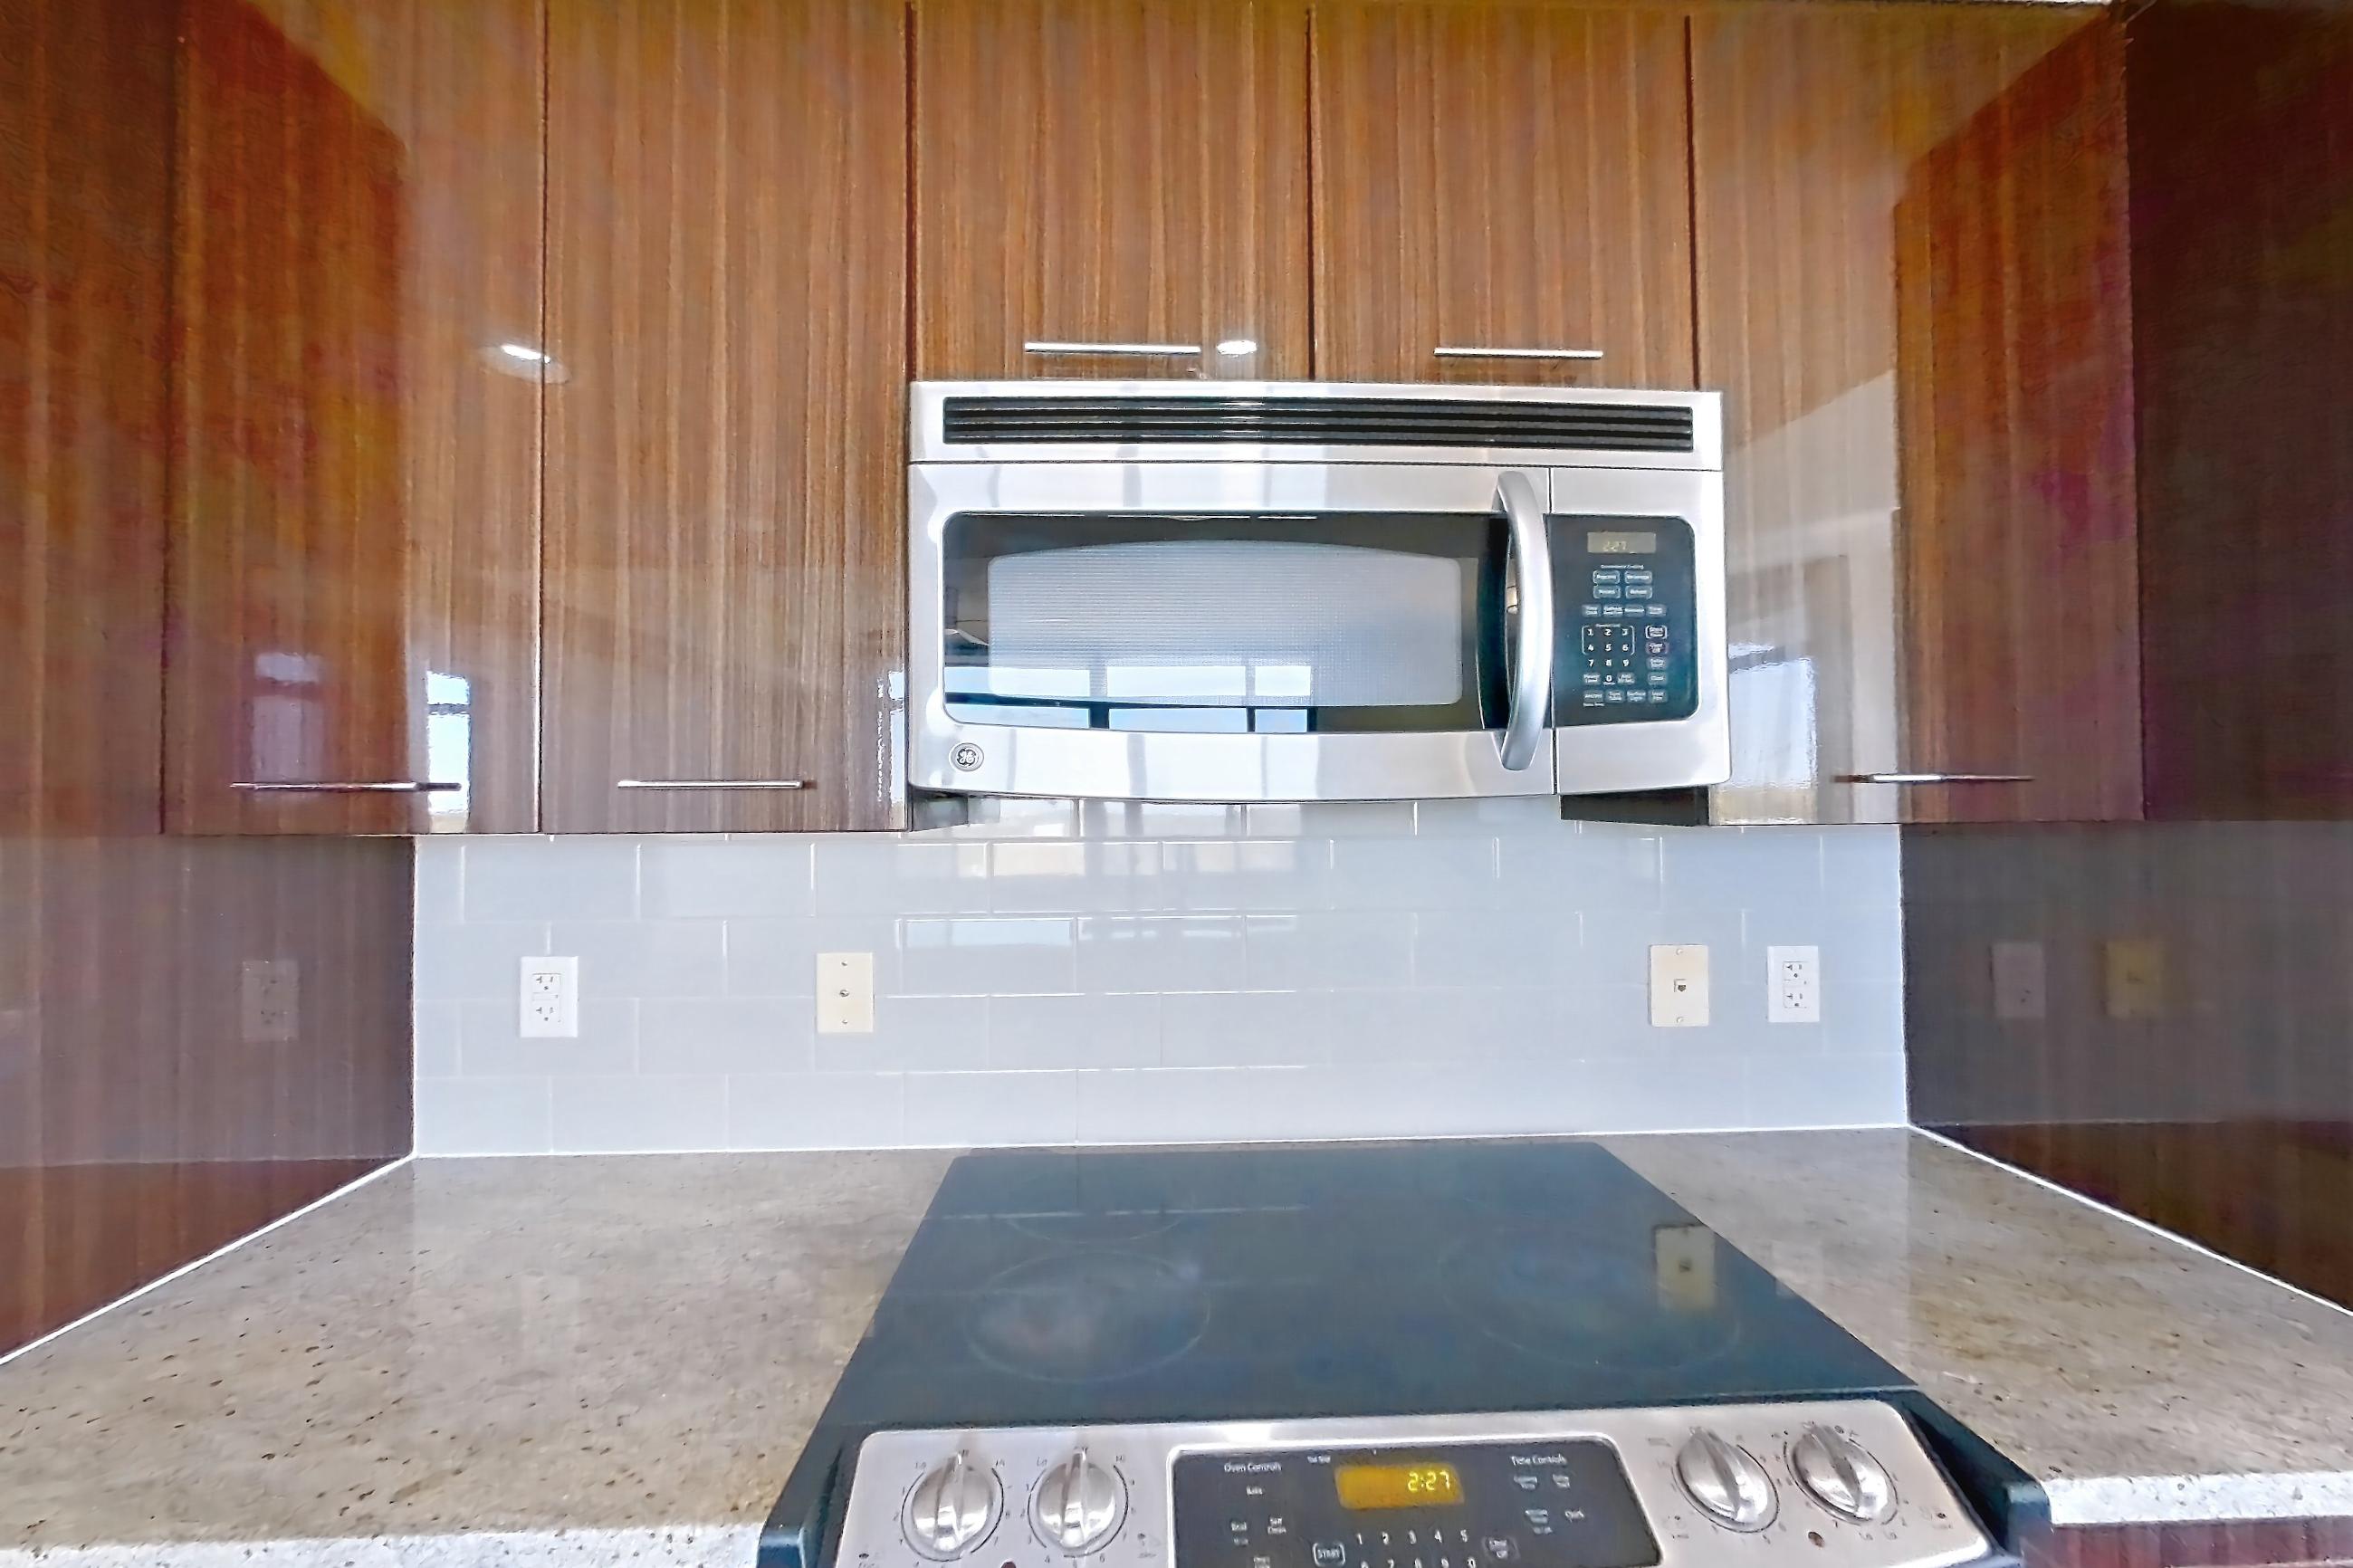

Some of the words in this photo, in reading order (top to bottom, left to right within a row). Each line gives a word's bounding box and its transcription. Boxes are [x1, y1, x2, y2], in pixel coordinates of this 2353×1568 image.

[1587, 628, 1594, 636] 1
[1604, 628, 1612, 636] 2
[1587, 644, 1594, 652] 4
[1605, 644, 1612, 652] 5
[1621, 644, 1629, 652] 6
[1588, 659, 1594, 667] 7
[1622, 659, 1630, 667] 9
[1407, 1469, 1450, 1492] 2:27
